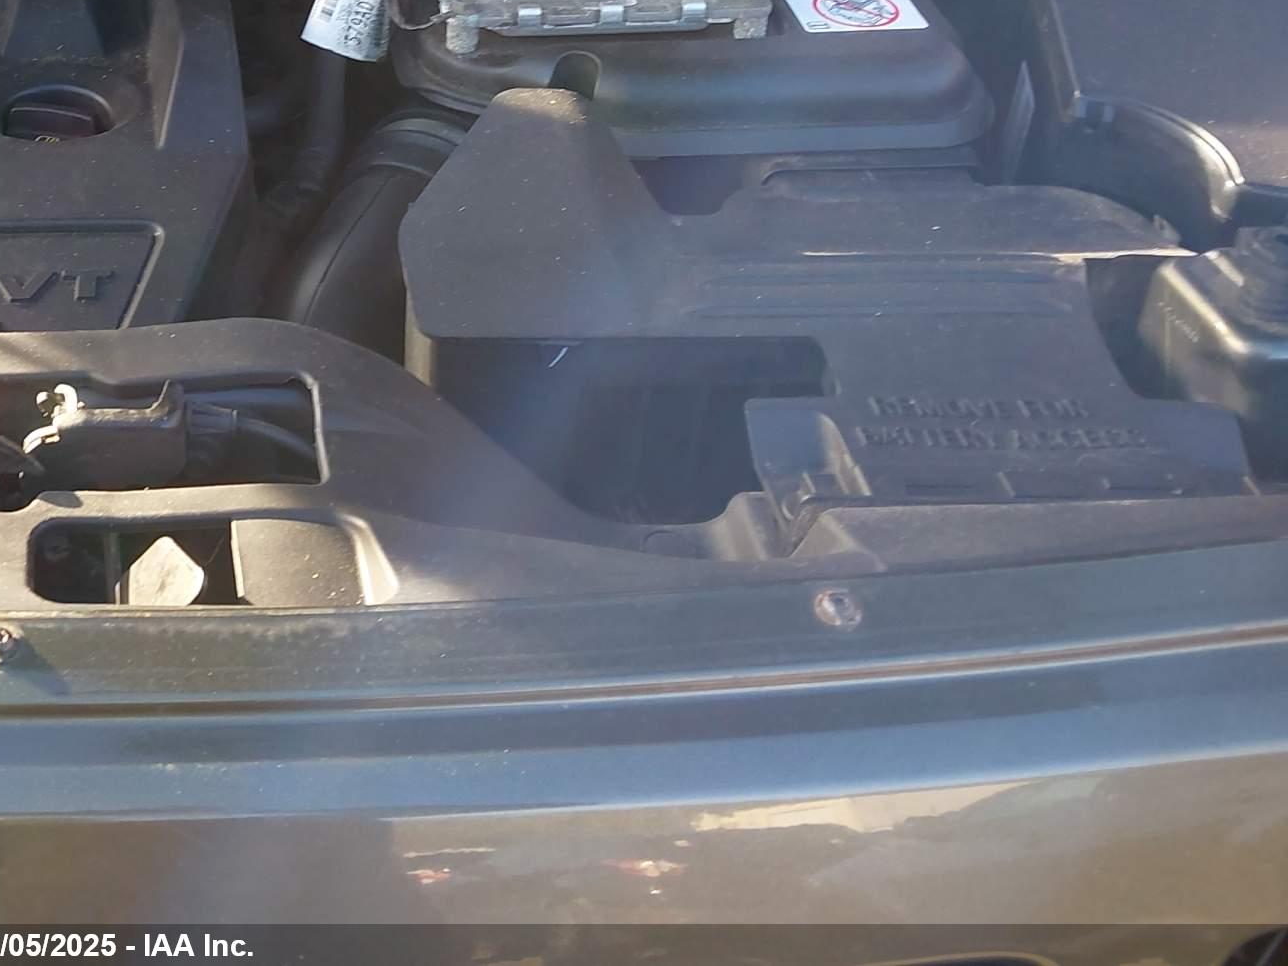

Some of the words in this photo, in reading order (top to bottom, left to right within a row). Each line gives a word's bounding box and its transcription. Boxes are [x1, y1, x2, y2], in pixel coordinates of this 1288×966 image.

[867, 395, 1011, 419] REMOVE
[1016, 397, 1091, 419] FOR
[855, 425, 998, 449] BATTERY
